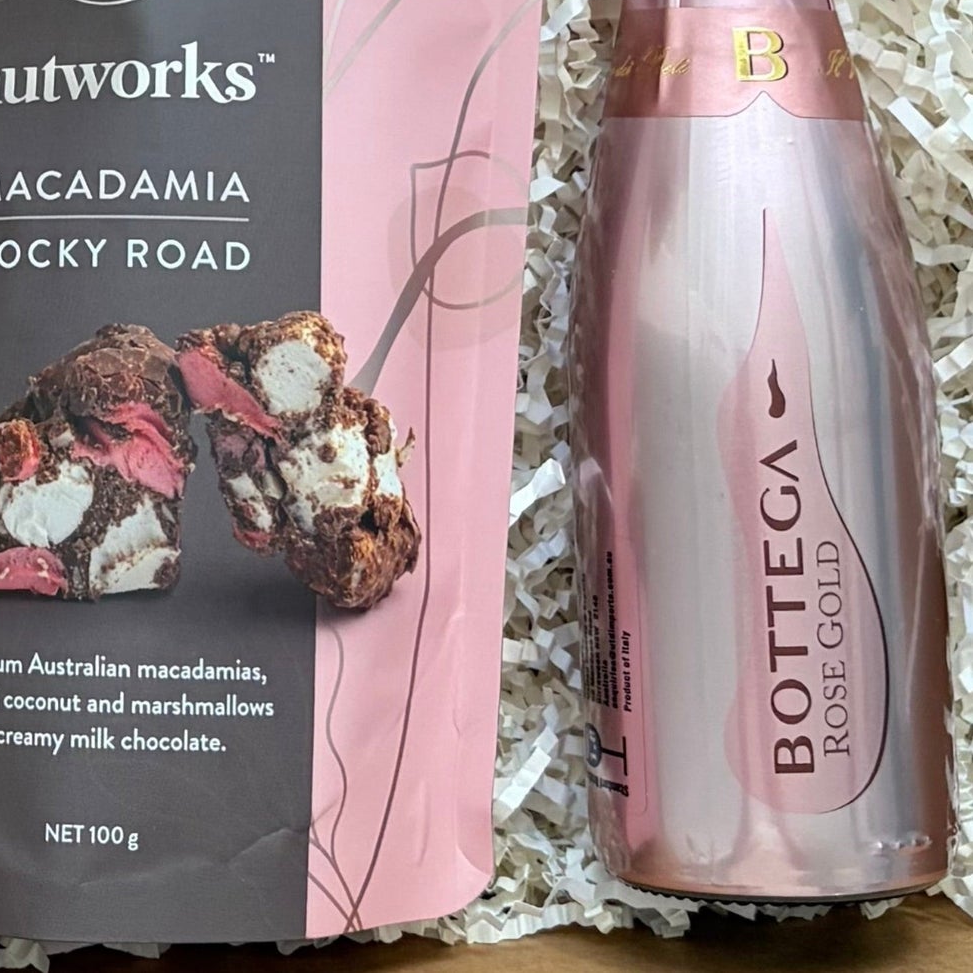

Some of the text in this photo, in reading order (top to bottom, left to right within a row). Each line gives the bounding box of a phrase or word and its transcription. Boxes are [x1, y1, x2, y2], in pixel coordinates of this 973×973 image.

[732, 26, 789, 82] B
[126, 239, 251, 271] ROAD
[758, 439, 815, 774] BOTTEGA
[816, 541, 850, 757] ROSE GOLD
[27, 652, 131, 678] Australian
[137, 658, 268, 685] macadamias,
[621, 630, 633, 713] Product of Italy
[3, 695, 81, 713] coconut
[87, 691, 124, 714] and
[131, 694, 274, 717] marshmallows
[70, 727, 115, 750] milk
[120, 728, 227, 752] chocolate.
[45, 823, 139, 851] NET 100 g
